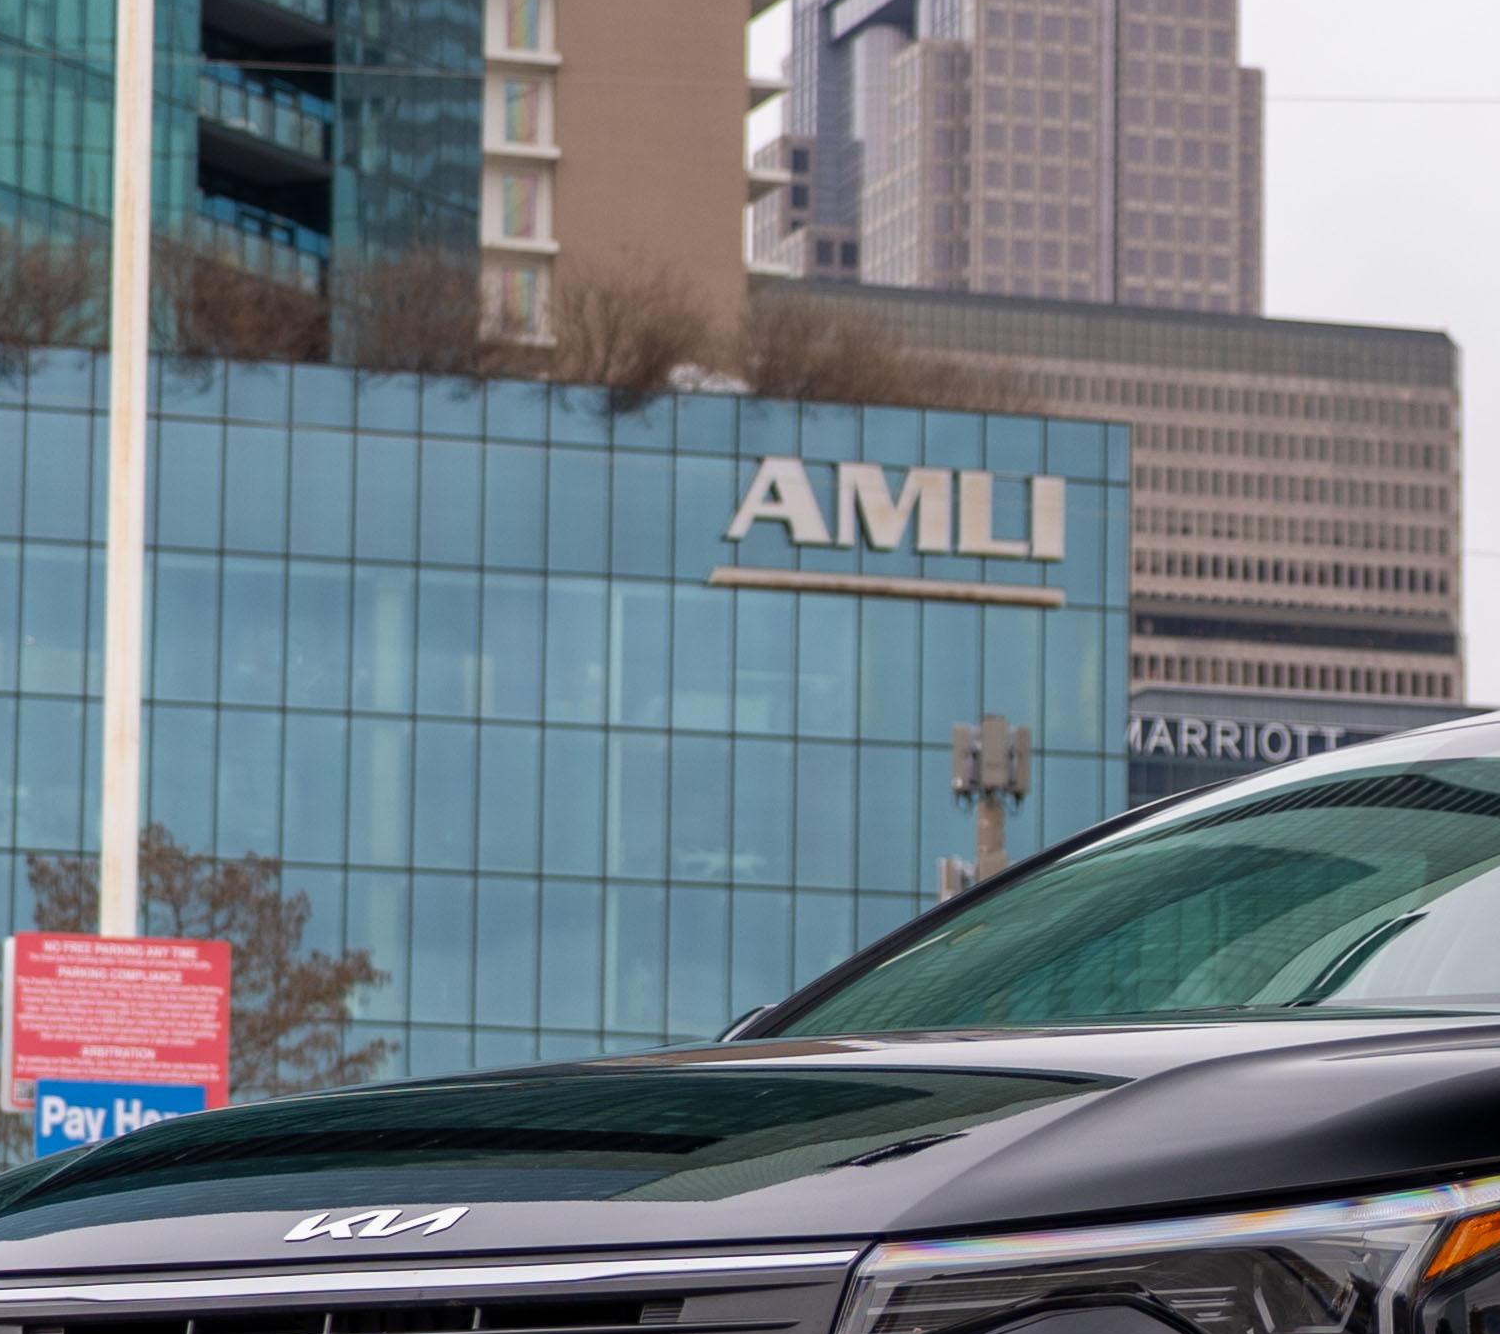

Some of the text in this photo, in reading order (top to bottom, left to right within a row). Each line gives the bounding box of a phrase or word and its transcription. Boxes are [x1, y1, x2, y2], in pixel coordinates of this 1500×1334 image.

[726, 455, 1066, 561] AMLI
[95, 942, 142, 956] PARKING
[41, 1095, 106, 1144] Pay
[283, 1206, 470, 1242] KIA
